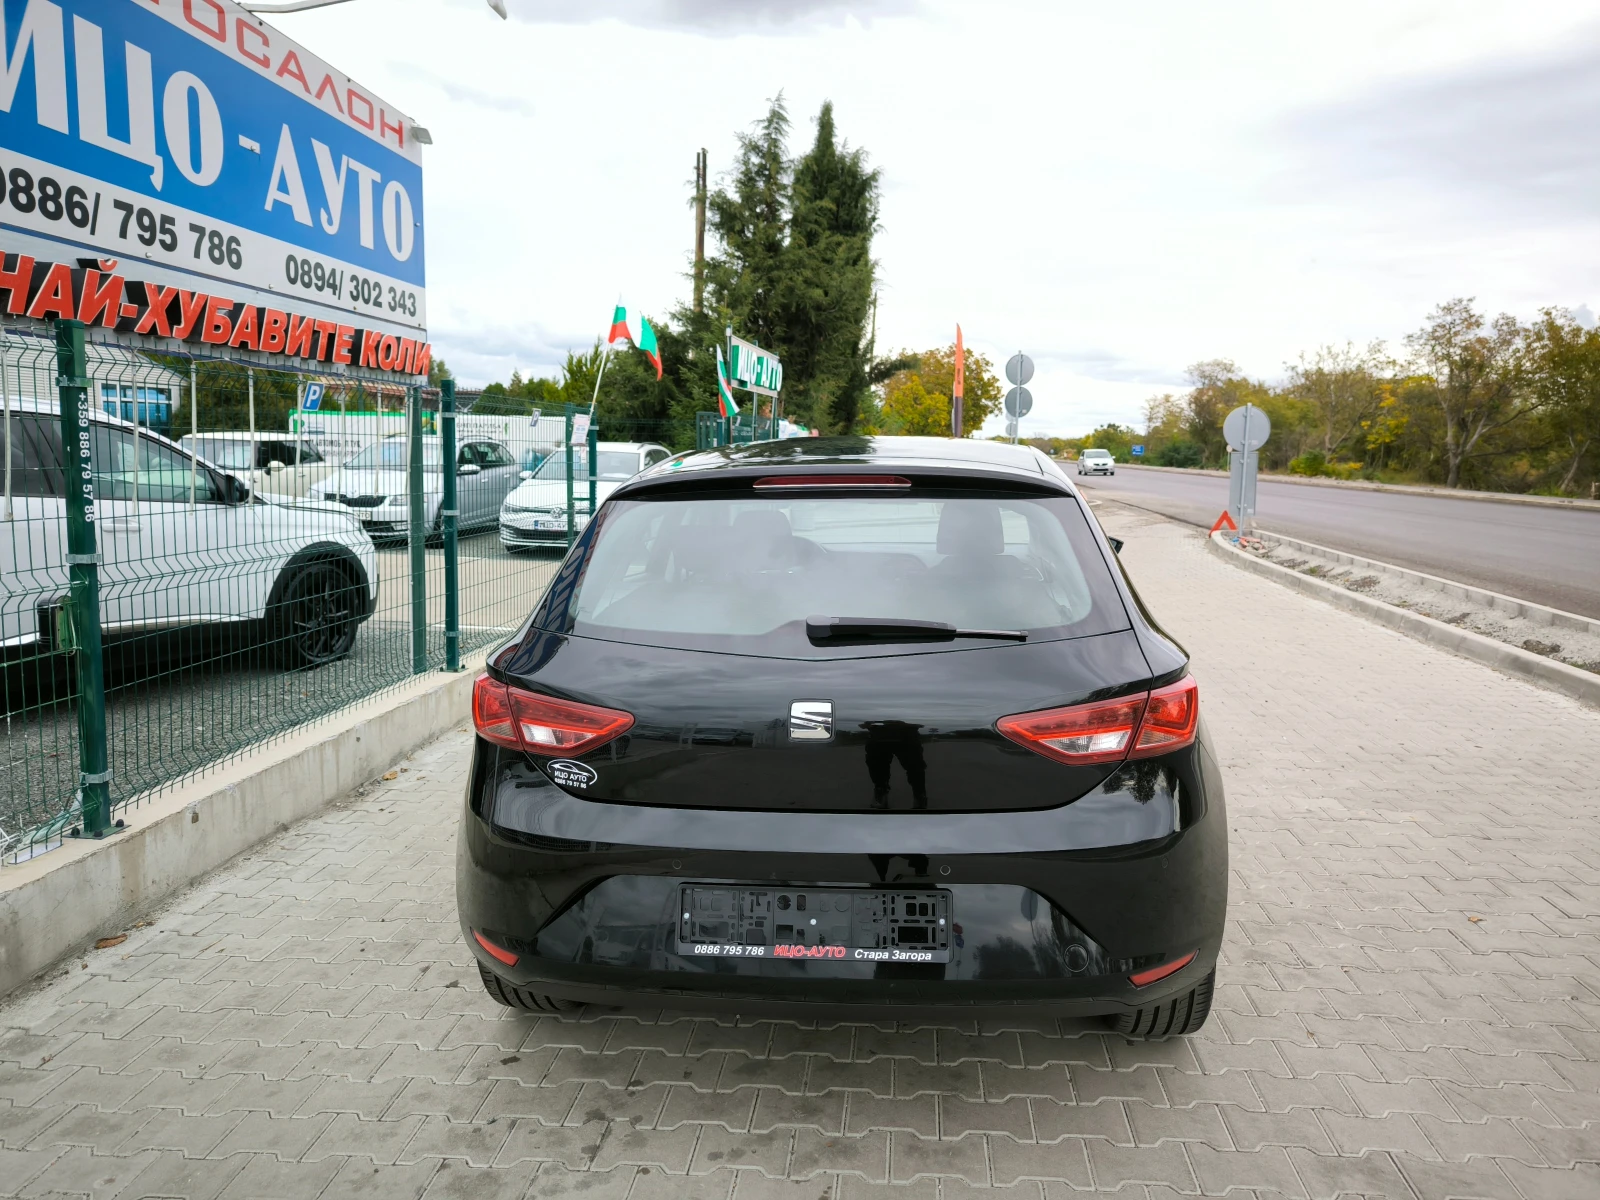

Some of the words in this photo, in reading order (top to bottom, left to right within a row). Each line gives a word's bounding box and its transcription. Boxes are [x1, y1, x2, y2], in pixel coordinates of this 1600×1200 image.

[150, 0, 404, 149] ОСАЛОН
[113, 198, 178, 252] 795
[189, 223, 242, 270] 786
[285, 254, 344, 301] 0894/
[349, 274, 383, 308] 302
[388, 286, 416, 317] 343
[0, 250, 355, 365] НАЙ-ХУБАВИТЕ
[359, 329, 431, 376] КОЛИ
[306, 385, 320, 407] P
[77, 392, 89, 427] +359
[79, 432, 91, 457] 886
[81, 462, 92, 479] 79
[83, 484, 94, 500] 57
[84, 505, 95, 522] 86
[554, 771, 568, 779] ИЦО
[569, 773, 587, 782] АУТО
[694, 945, 721, 954] 0886
[723, 945, 743, 955] 795
[745, 946, 765, 956] 786
[773, 944, 847, 959] ИЦО-АУТО
[854, 949, 889, 961] Стара
[891, 950, 932, 962] Загора
